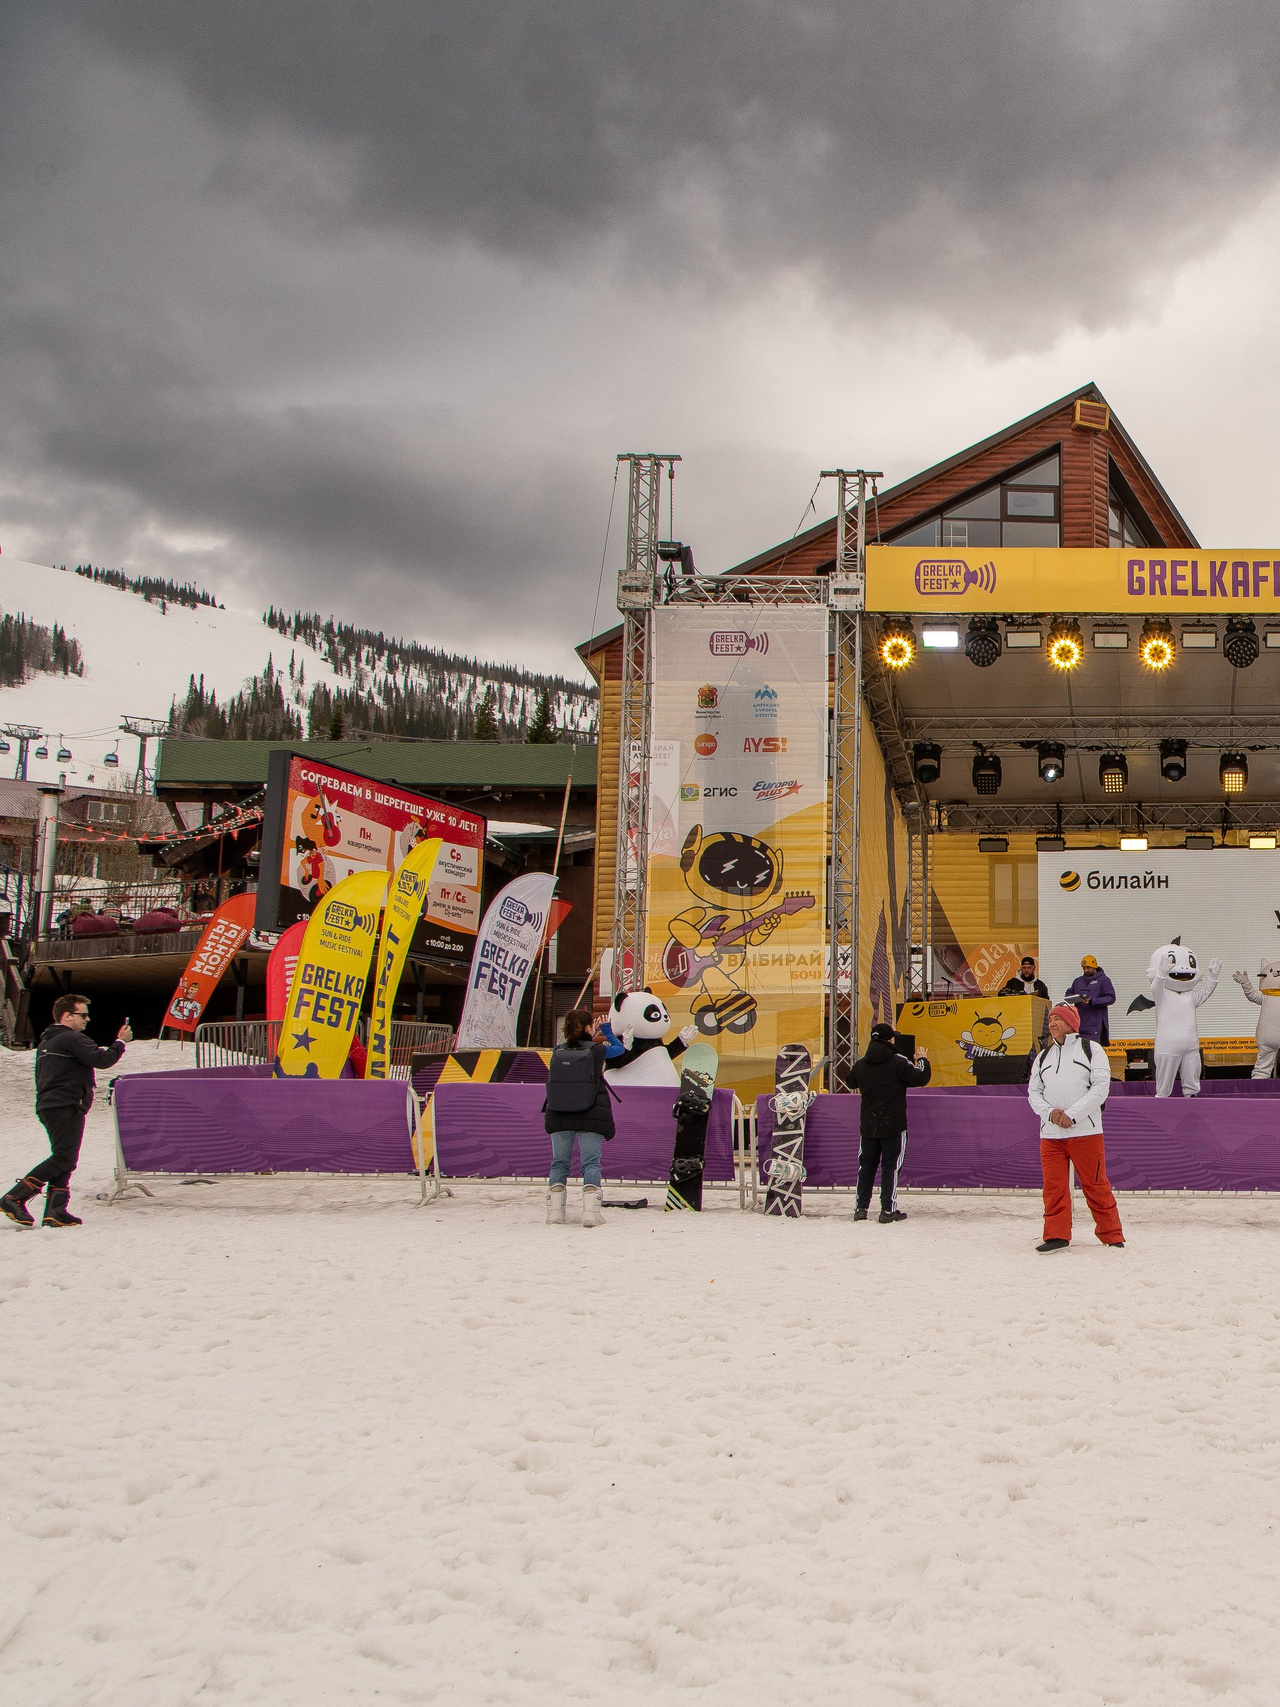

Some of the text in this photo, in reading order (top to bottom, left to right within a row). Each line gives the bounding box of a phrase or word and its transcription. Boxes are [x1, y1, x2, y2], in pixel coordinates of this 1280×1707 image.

[922, 565, 962, 578] GRELKA
[922, 578, 950, 591] FEST
[715, 634, 743, 644] GRELKA
[715, 644, 734, 653] FEST
[743, 737, 788, 753] AYS!
[703, 787, 738, 797] 2ГИС
[300, 768, 478, 833] СОГРЕВАЕМ В ШЕРЕГЕШЕ УЖЕ 10 ЛЕТ!
[347, 840, 382, 854] квартирник
[450, 848, 463, 862] Ср.
[445, 868, 466, 879] концерт
[1086, 871, 1170, 890] билайн
[331, 902, 354, 917] GRELKA
[502, 908, 516, 919] FEST
[506, 899, 525, 914] GRELKA
[328, 913, 344, 925] FEST
[232, 929, 248, 948] ВКУСНО
[321, 928, 332, 938] SUN
[339, 934, 352, 943] RIDE
[190, 918, 229, 973] МАНТЫ
[201, 923, 241, 976] ПОНТЫ
[320, 939, 363, 957] MUSIC FESTIVAL
[430, 939, 445, 948] 10:00
[452, 944, 464, 952] 2:00
[480, 940, 529, 978] GRELKA
[301, 963, 365, 999] GRELKA
[474, 961, 521, 1006] FEST
[293, 988, 359, 1032] FEST
